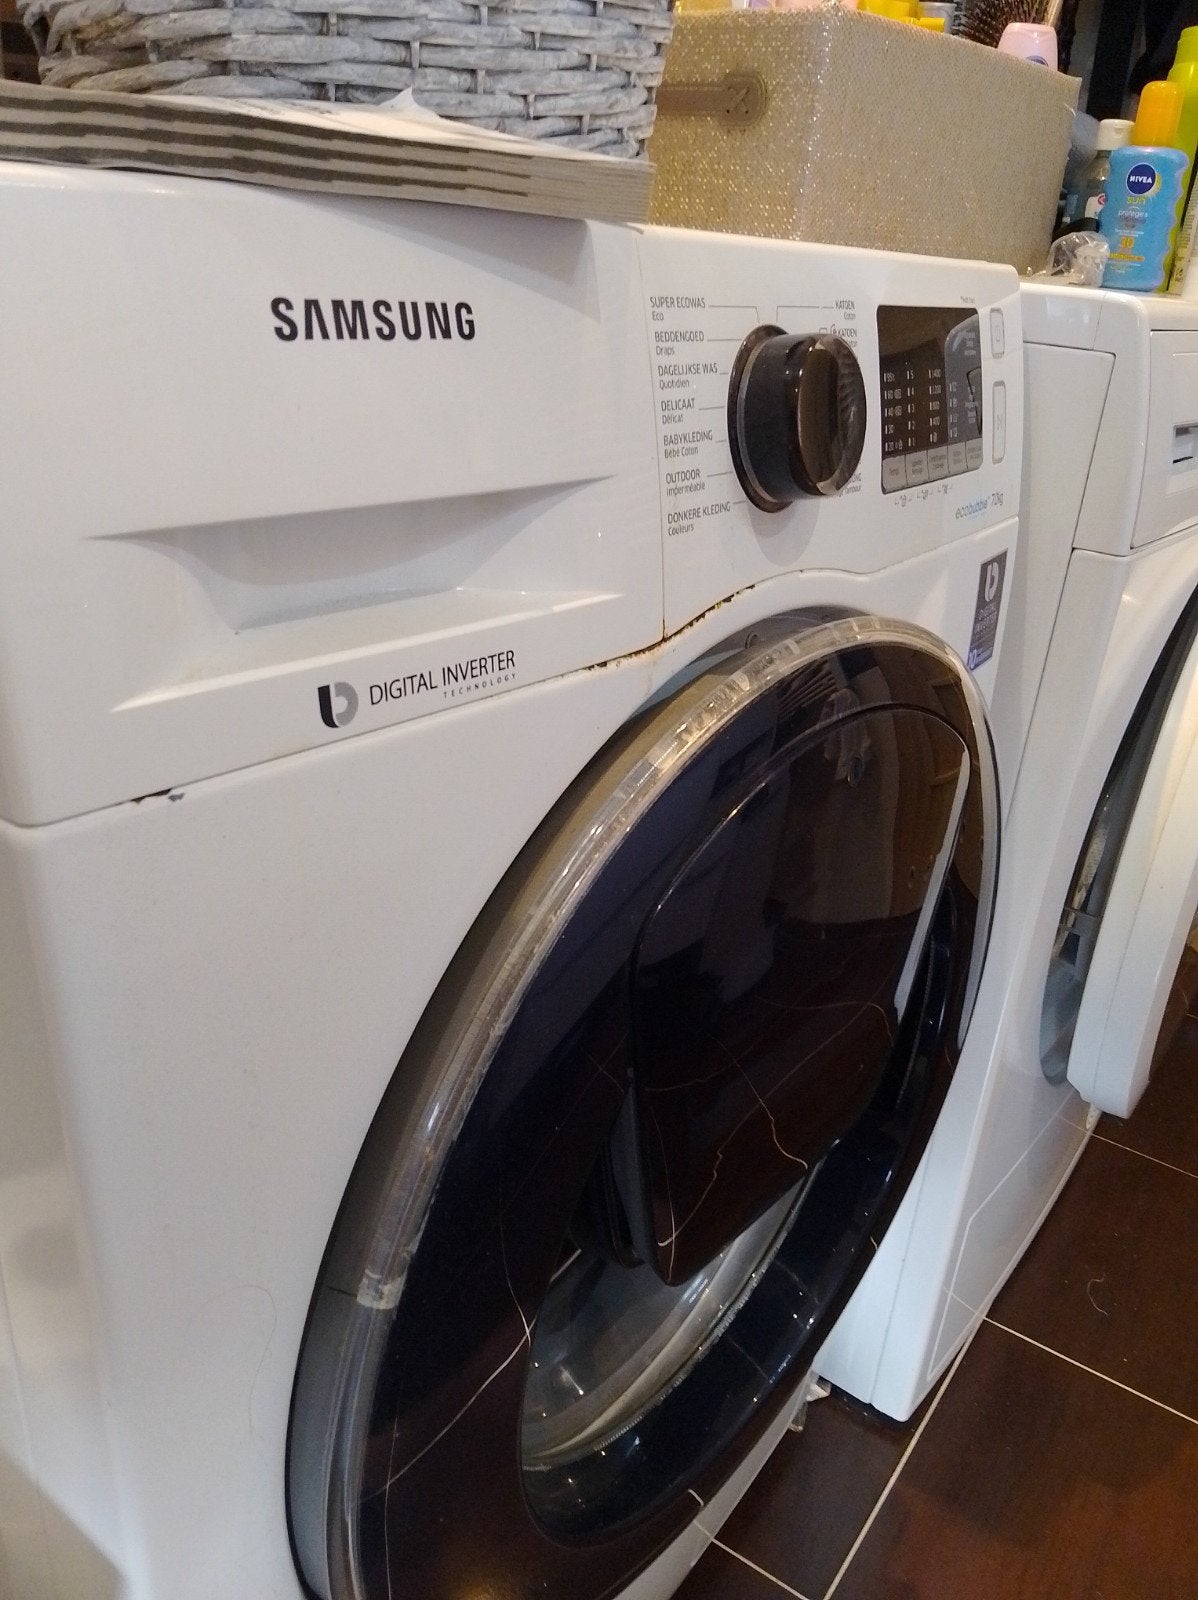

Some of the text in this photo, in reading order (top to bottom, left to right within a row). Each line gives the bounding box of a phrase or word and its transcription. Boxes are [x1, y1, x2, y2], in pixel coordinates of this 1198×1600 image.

[1129, 175, 1153, 184] NIVEA
[649, 297, 706, 309] SUPER ECOWAS
[270, 297, 476, 341] SAMSUNG
[651, 311, 665, 321] Eco
[654, 331, 705, 343] BEDDENGOED
[655, 345, 675, 357] Draps
[657, 362, 718, 377] DAGELIJKSE WAS
[658, 378, 690, 391] Quotidien
[660, 398, 696, 412] DELICAAT
[661, 413, 684, 425] Délicat
[663, 430, 713, 447] BABYKLEDING
[680, 446, 699, 458] Coton
[665, 468, 701, 485] OUTDOOR
[667, 501, 731, 525] DONKERE KLEDING
[667, 523, 694, 537] Couleurs
[369, 650, 516, 706] DIGITAL INVERTER
[443, 673, 517, 699] TECHNOLOGY
